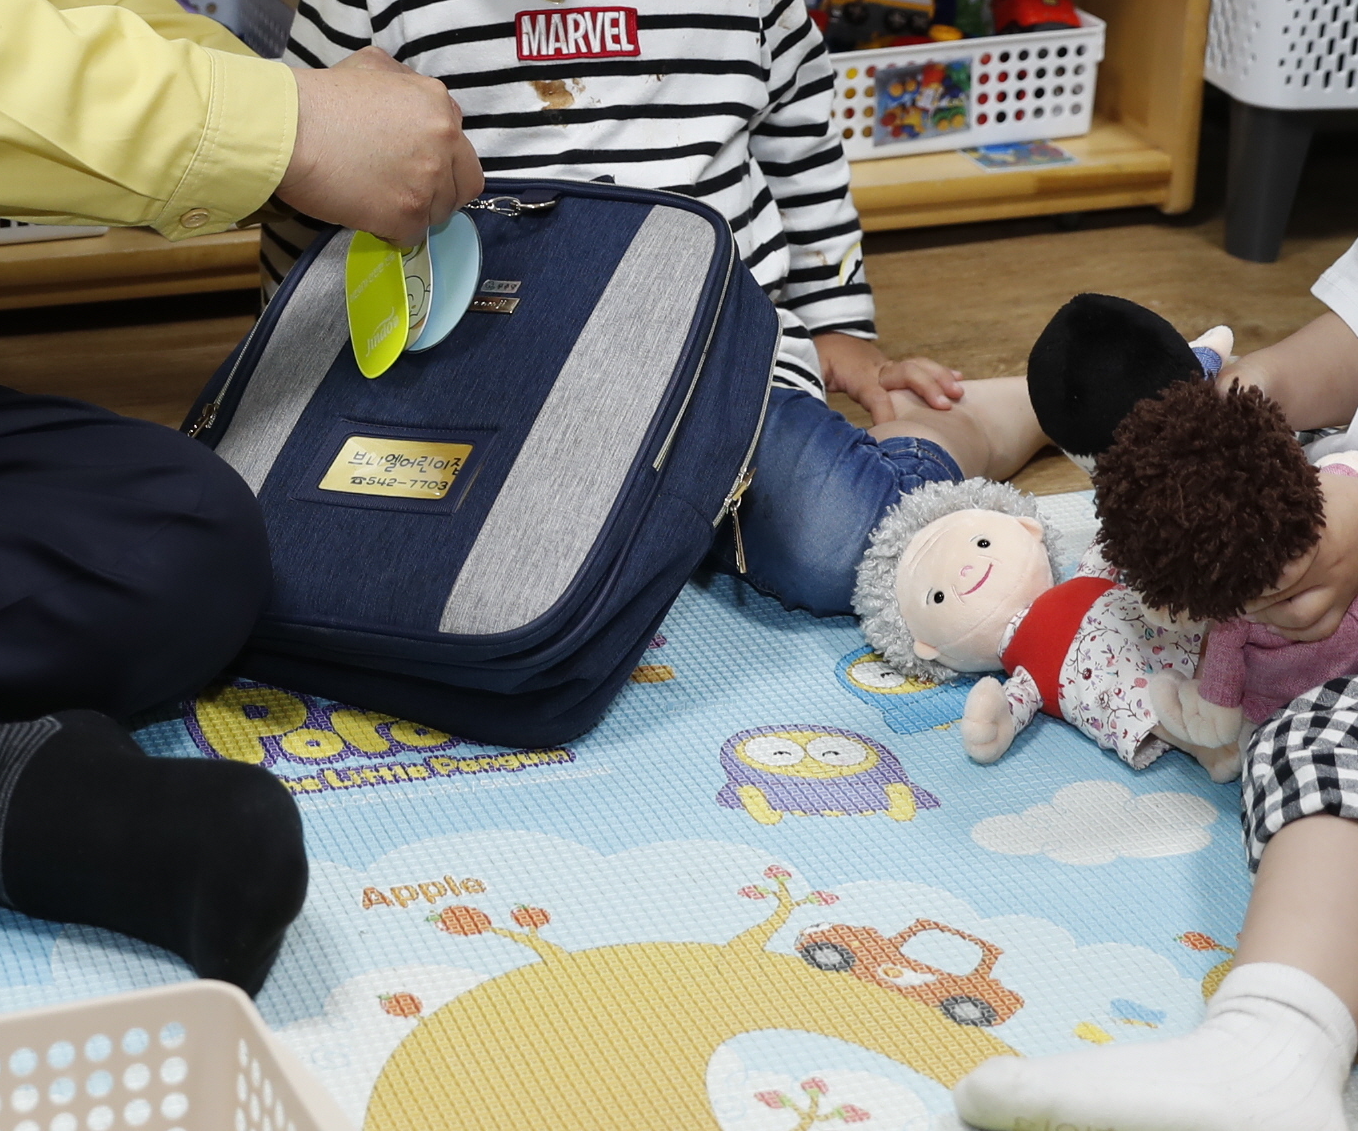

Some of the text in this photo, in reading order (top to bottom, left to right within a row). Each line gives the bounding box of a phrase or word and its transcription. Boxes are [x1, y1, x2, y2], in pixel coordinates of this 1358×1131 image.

[521, 10, 636, 57] MARVEL
[365, 476, 449, 491] 542-7703
[283, 775, 326, 794] he
[320, 761, 430, 789] Little
[424, 748, 576, 777] Penguin
[362, 874, 487, 910] Apple
